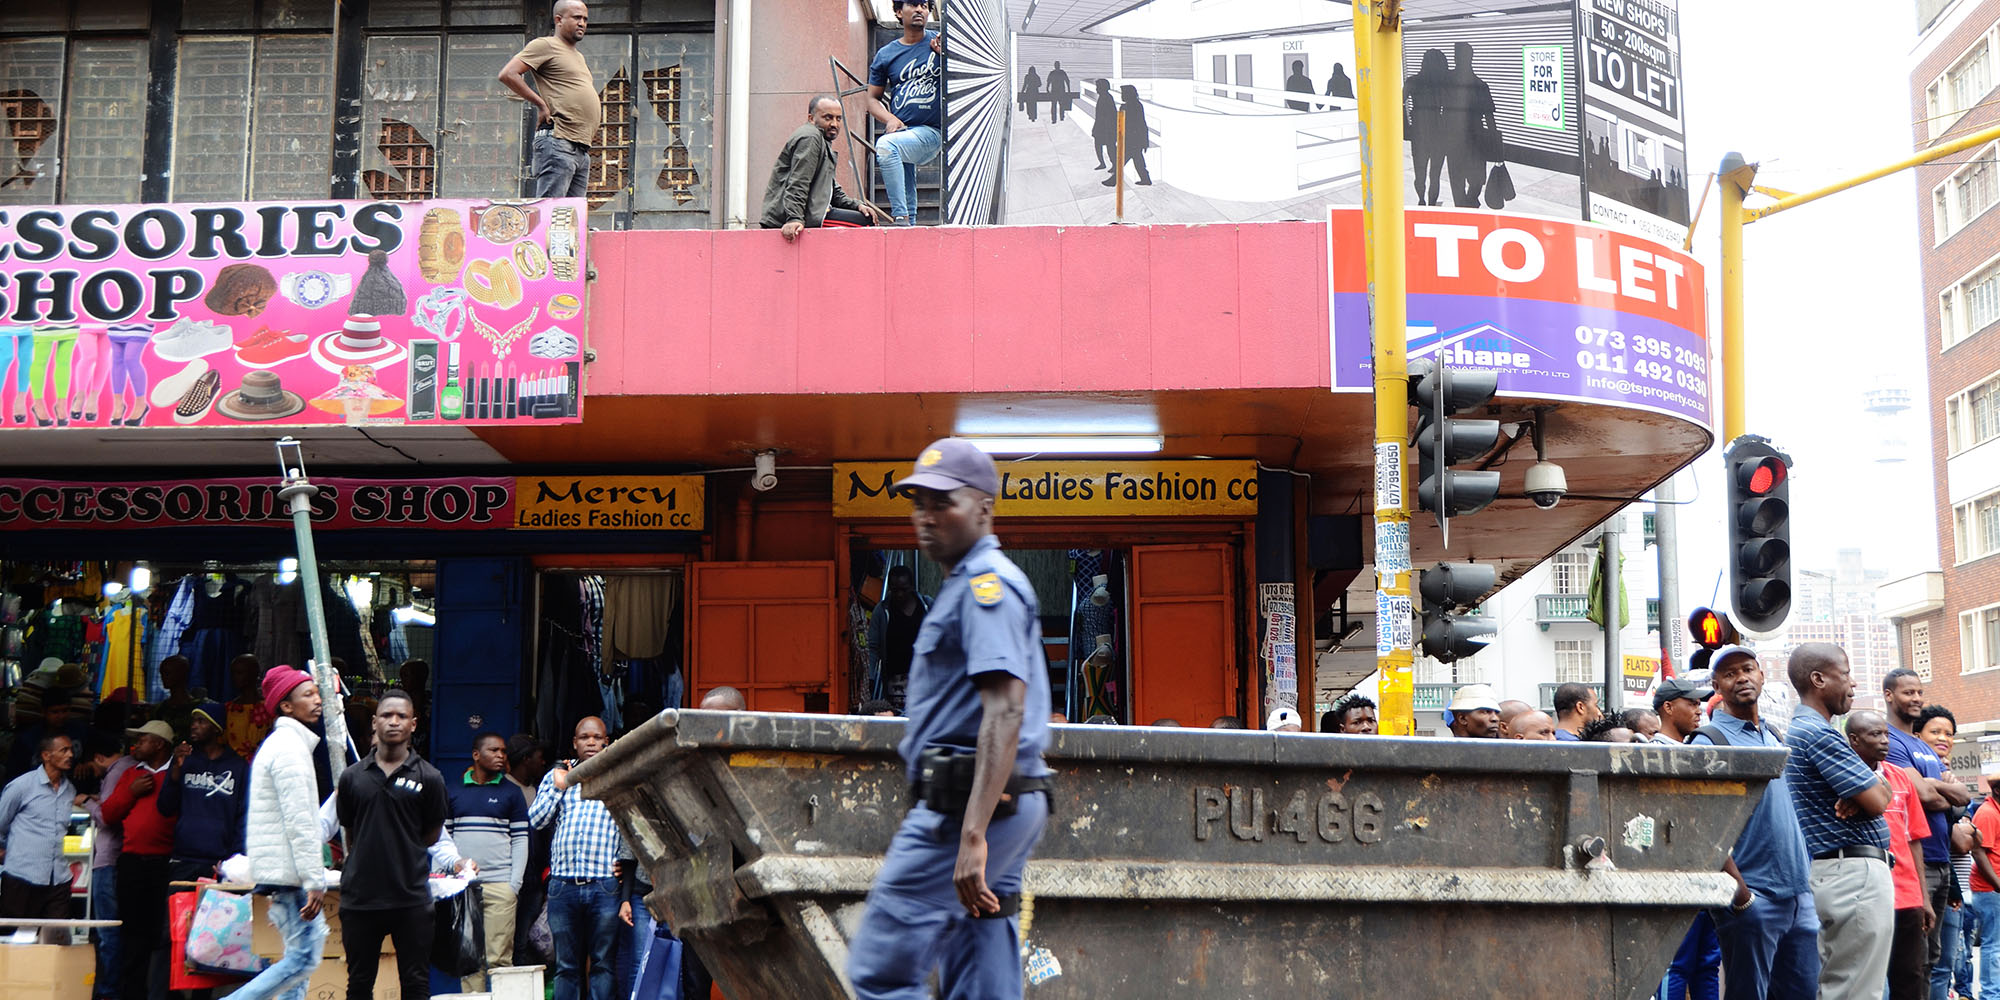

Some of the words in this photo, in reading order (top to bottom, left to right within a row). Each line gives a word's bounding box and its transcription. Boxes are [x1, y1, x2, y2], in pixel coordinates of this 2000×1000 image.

[1626, 2, 1665, 37] SHOPS
[1282, 40, 1305, 51] EXIT
[1600, 19, 1616, 41] 50
[1624, 29, 1667, 66] 200sqm
[900, 51, 941, 82] Jack
[1530, 52, 1556, 62] STORE
[1533, 65, 1553, 78] FOR
[1590, 42, 1626, 90] TO
[1631, 61, 1676, 112] LET
[894, 78, 938, 109] Jones
[1530, 79, 1558, 93] RENT
[1592, 203, 1628, 225] CONTACT
[0, 203, 404, 262] SSORIES
[1414, 222, 1545, 284] TO
[1575, 236, 1684, 311] LET
[1434, 341, 1531, 368] shape
[1464, 336, 1512, 353] TAKE
[1575, 325, 1626, 350] 073
[1631, 334, 1672, 360] 395
[1674, 346, 1706, 375] 2093
[1440, 364, 1518, 374] ANAGEMENT
[1551, 371, 1571, 379] LTD
[1576, 350, 1628, 374] 011
[1633, 358, 1674, 384] 492
[1676, 369, 1707, 398] 0330
[1586, 375, 1705, 413] info@tsproperty.co.za
[1001, 471, 1094, 501] Ladies
[1105, 471, 1218, 501] Fashion
[1227, 477, 1258, 501] cc
[1387, 444, 1400, 505] 0717994050
[350, 484, 509, 523] SHOP
[535, 479, 677, 511] Mercy
[519, 508, 582, 528] Ladies
[588, 508, 664, 528] Fashion
[669, 511, 692, 528] cc
[1381, 543, 1404, 552] PILLS
[1265, 585, 1278, 595] 073
[1271, 613, 1280, 626] 081
[1269, 627, 1279, 641] 026
[1626, 658, 1651, 672] FLATS
[1626, 678, 1636, 688] TO
[1636, 679, 1648, 689] LET
[1195, 785, 1264, 842] PU
[1279, 788, 1385, 844] 466
[1030, 956, 1051, 972] REE
